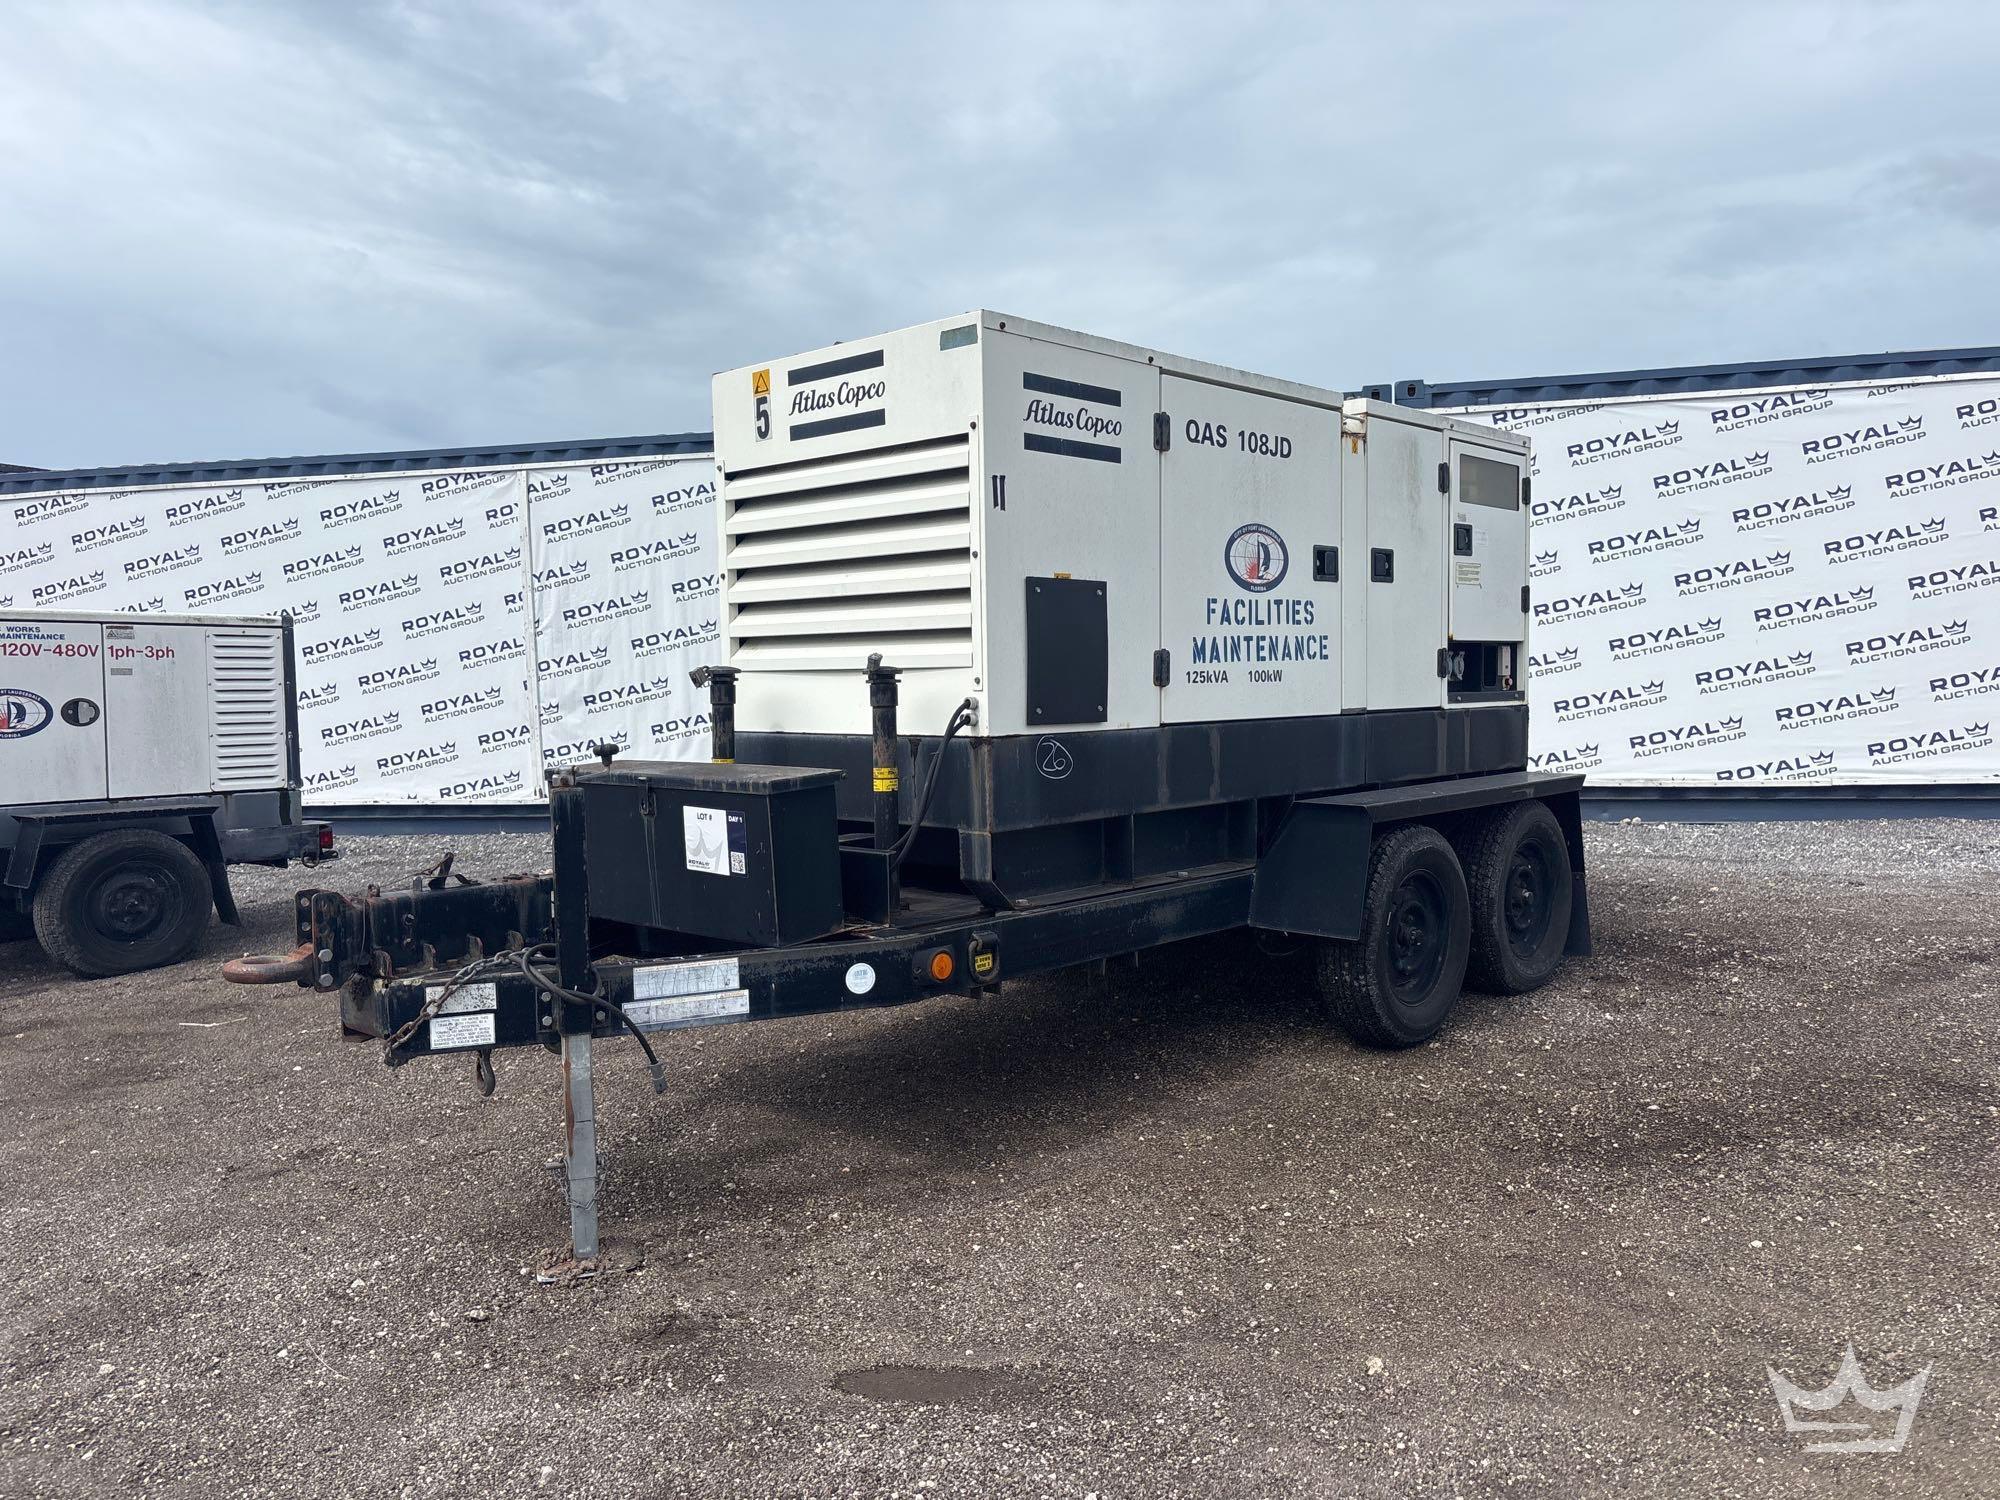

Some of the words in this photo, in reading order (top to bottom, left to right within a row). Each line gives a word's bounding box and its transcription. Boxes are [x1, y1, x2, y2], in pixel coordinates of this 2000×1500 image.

[789, 390, 835, 416] Atlas
[838, 381, 885, 407] Copco
[1711, 394, 1805, 424] ROYAL
[755, 396, 770, 440] 5
[1022, 399, 1074, 429] Atlas
[1077, 407, 1122, 437] Copco
[1716, 412, 1779, 432] AUCTION
[1782, 400, 1833, 417] GROUP
[1185, 419, 1228, 448] QAS
[1238, 430, 1292, 458] 108JD
[1567, 428, 1656, 457] ROYAL
[1572, 447, 1631, 467] AUCTION
[1634, 436, 1682, 452] GROUP
[1802, 424, 1898, 455] ROYAL
[1807, 444, 1871, 464] AUCTION
[1874, 432, 1927, 449] GROUP
[1653, 459, 1745, 489] ROYAL
[1658, 479, 1719, 499] AUCTION
[1722, 467, 1773, 484] GROUP
[1885, 458, 1982, 489] ROYAL
[1890, 479, 1956, 499] AUCTION
[1959, 468, 2000, 484] GROU
[425, 485, 469, 502] AUCTION
[471, 475, 506, 490] GROUP
[14, 496, 72, 519] ROYAL
[18, 511, 56, 528] AUCTION
[58, 502, 88, 515] GROUP
[166, 495, 227, 519] ROYAL
[170, 511, 211, 528] AUCTION
[213, 502, 245, 515] GROUP
[320, 497, 384, 521] ROYAL
[324, 513, 366, 530] AUCTION
[369, 504, 402, 517] GROUP
[1733, 493, 1827, 523] ROYAL
[1737, 513, 1800, 532] AUCTION
[1804, 501, 1855, 518] GROUP
[72, 522, 130, 545] ROYAL
[221, 524, 283, 548] ROYAL
[383, 524, 447, 548] ROYAL
[544, 511, 611, 536] ROYAL
[547, 527, 593, 545] AUCTION
[596, 518, 631, 531] GROUP
[75, 537, 114, 554] AUCTION
[117, 529, 147, 541] GROUP
[225, 540, 266, 557] AUCTION
[269, 531, 301, 544] GROUP
[387, 540, 430, 558] AUCTION
[432, 531, 466, 544] GROUP
[611, 539, 680, 564] ROYAL
[1588, 526, 1677, 554] ROYAL
[1593, 545, 1652, 564] AUCTION
[1655, 534, 1704, 550] GROUP
[1824, 525, 1921, 555] ROYAL
[1829, 545, 1894, 565] AUCTION
[1897, 533, 1950, 550] GROUP
[124, 550, 184, 573] ROYAL
[128, 566, 168, 582] AUCTION
[171, 557, 202, 570] GROUP
[440, 553, 505, 578] ROYAL
[615, 556, 661, 573] AUCTION
[664, 546, 700, 560] GROUP
[1674, 558, 1767, 587] ROYAL
[32, 576, 90, 599] ROYAL
[185, 577, 246, 600] ROYAL
[444, 570, 487, 587] AUCTION
[1679, 578, 1741, 597] AUCTION
[1744, 567, 1794, 583] GROUP
[1908, 561, 2000, 590] ROYAL
[36, 591, 74, 608] AUCTION
[77, 583, 107, 595] GROUP
[188, 593, 230, 609] AUCTION
[232, 584, 264, 597] GROUP
[339, 580, 402, 604] ROYAL
[343, 596, 385, 613] AUCTION
[388, 587, 421, 600] GROUP
[1534, 589, 1620, 617] ROYAL
[1912, 581, 1978, 600] AUCTION
[563, 597, 631, 621] ROYAL
[567, 613, 613, 631] AUCTION
[616, 604, 651, 618] GROUP
[1206, 598, 1315, 626] FACILITIES
[1538, 608, 1596, 626] AUCTION
[1599, 598, 1646, 613] GROUP
[1754, 593, 1849, 622] ROYAL
[1759, 613, 1822, 632] AUCTION
[1825, 602, 1877, 618] GROUP
[302, 634, 365, 657] ROYAL
[460, 638, 523, 662] ROYAL
[631, 626, 700, 650] ROYAL
[635, 642, 681, 659] AUCTION
[684, 634, 720, 647] GROUP
[1192, 635, 1329, 664] MAINTENANCE
[1609, 624, 1698, 651] ROYAL
[1613, 643, 1673, 661] AUCTION
[1676, 633, 1725, 648] GROUP
[1846, 627, 1943, 655] ROYAL
[1851, 647, 1916, 665] AUCTION
[1919, 636, 1972, 652] GROUP
[0, 643, 99, 657] 120V-480V
[107, 645, 175, 660] 1ph-3ph
[306, 650, 348, 666] AUCTION
[350, 641, 383, 654] GROUP
[463, 654, 506, 671] AUCTION
[1185, 669, 1229, 684] 125kVA
[1247, 669, 1283, 683] 100kW
[1695, 658, 1788, 685] ROYAL
[1700, 677, 1762, 695] AUCTION
[1765, 667, 1816, 682] GROUP
[421, 692, 485, 715] ROYAL
[584, 683, 652, 706] ROYAL
[588, 699, 633, 715] AUCTION
[636, 690, 671, 703] GROUP
[1554, 687, 1641, 713] ROYAL
[1934, 683, 2000, 702] AUCTION
[425, 708, 468, 724] AUCTION
[470, 700, 504, 712] GROUP
[1558, 705, 1617, 722] AUCTION
[1620, 696, 1667, 710] GROUP
[1775, 694, 1871, 721] ROYAL
[1780, 713, 1844, 731] AUCTION
[1847, 703, 1899, 718] GROUP
[322, 717, 384, 739] ROYAL
[325, 732, 367, 748] AUCTION
[369, 724, 402, 737] GROUP
[1629, 722, 1719, 749] ROYAL
[1634, 741, 1694, 758] AUCTION
[1697, 732, 1746, 746] GROUP
[1868, 729, 1964, 756] ROYAL
[1872, 748, 1937, 766] AUCTION
[1940, 738, 1993, 754] GROUP
[377, 747, 440, 769] ROYAL
[381, 763, 423, 778] AUCTION
[426, 755, 459, 767] GROUP
[697, 812, 707, 820] LOT
[728, 815, 738, 823] DAY
